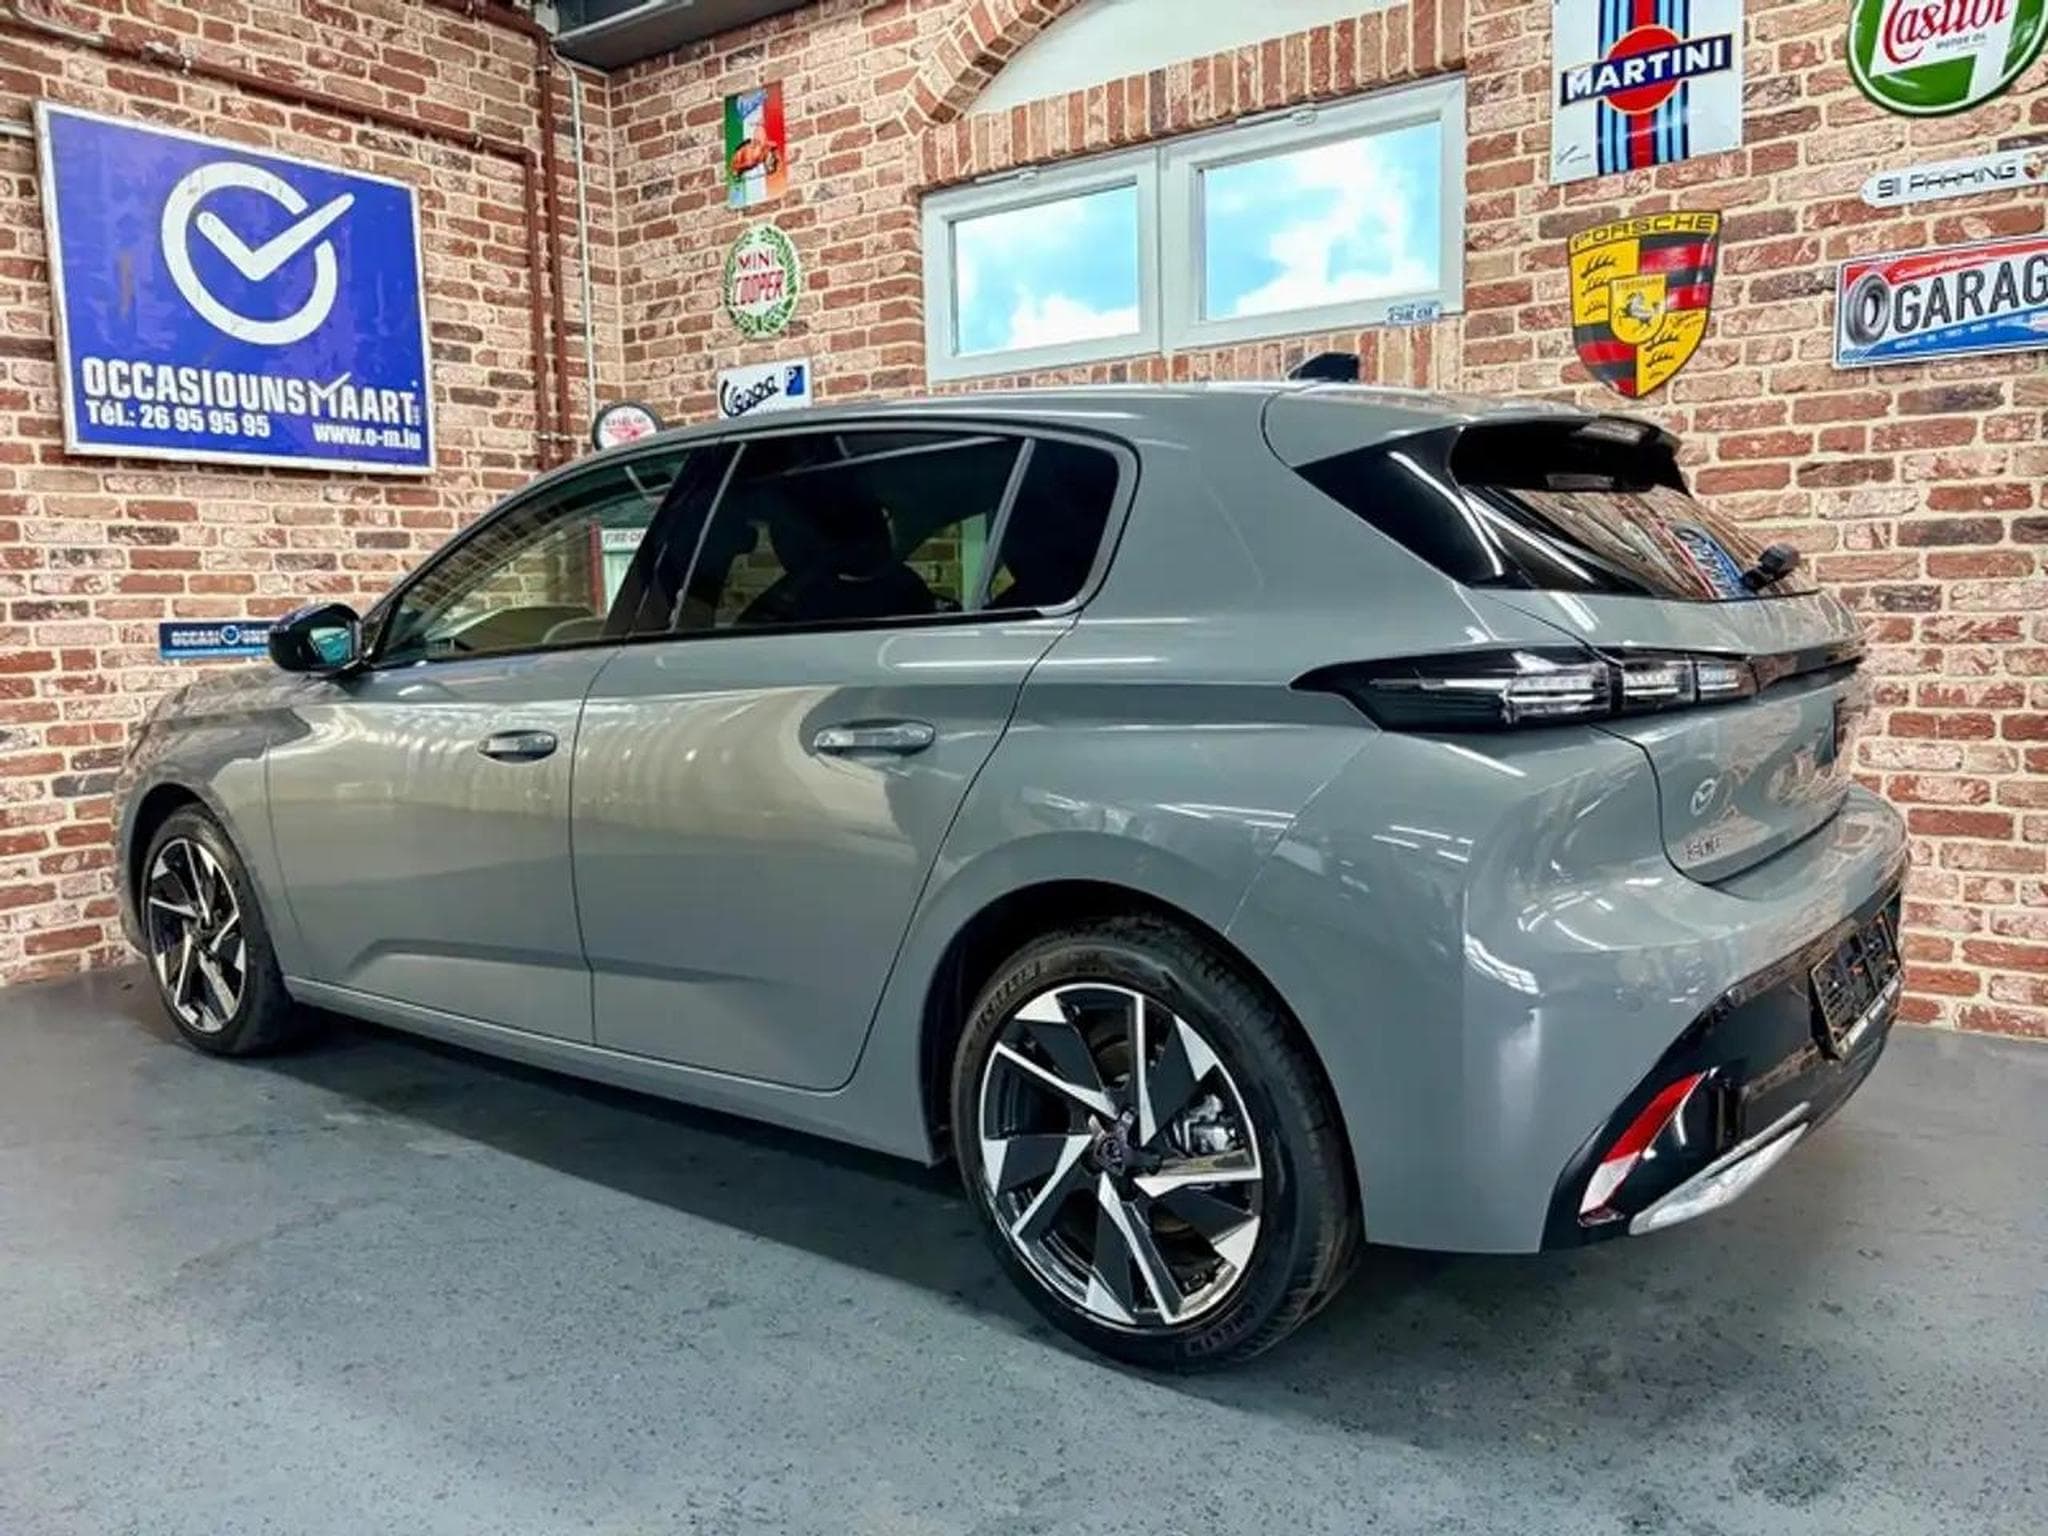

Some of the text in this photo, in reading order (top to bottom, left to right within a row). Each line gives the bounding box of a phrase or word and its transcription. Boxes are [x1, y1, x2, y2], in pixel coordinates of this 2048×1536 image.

[1566, 38, 1724, 101] MARTINI
[1908, 159, 2017, 193] PARKING
[1573, 214, 1715, 250] PORSCHE
[738, 249, 775, 270] MINI
[731, 269, 785, 306] COOPER
[719, 378, 779, 417] Vespa
[140, 403, 170, 430] 26
[174, 406, 204, 433] 95
[207, 409, 238, 436] 95
[241, 412, 271, 438] 95
[312, 421, 421, 450] www.o-m.lu
